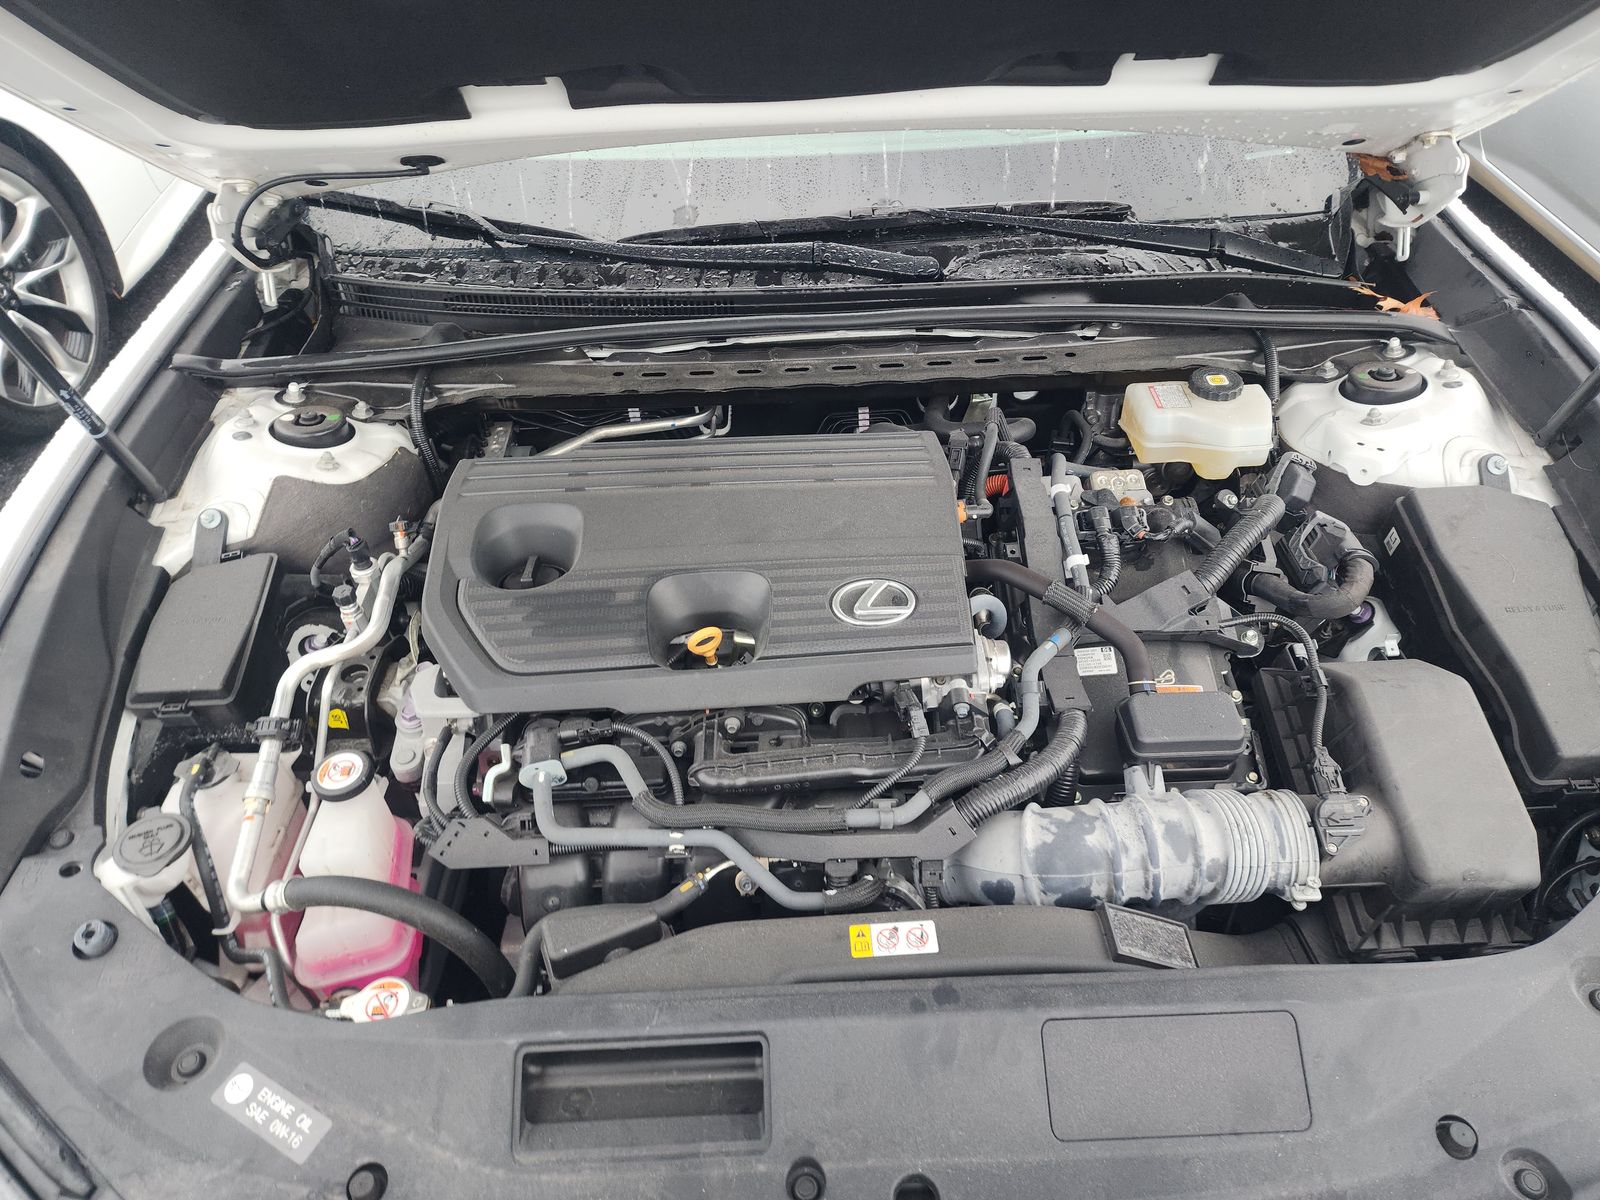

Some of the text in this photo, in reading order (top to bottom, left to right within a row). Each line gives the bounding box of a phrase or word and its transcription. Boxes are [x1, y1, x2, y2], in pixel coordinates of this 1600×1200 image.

[245, 1102, 303, 1149] SAE 0W-16
[257, 1086, 313, 1134] ENGINE OIL
